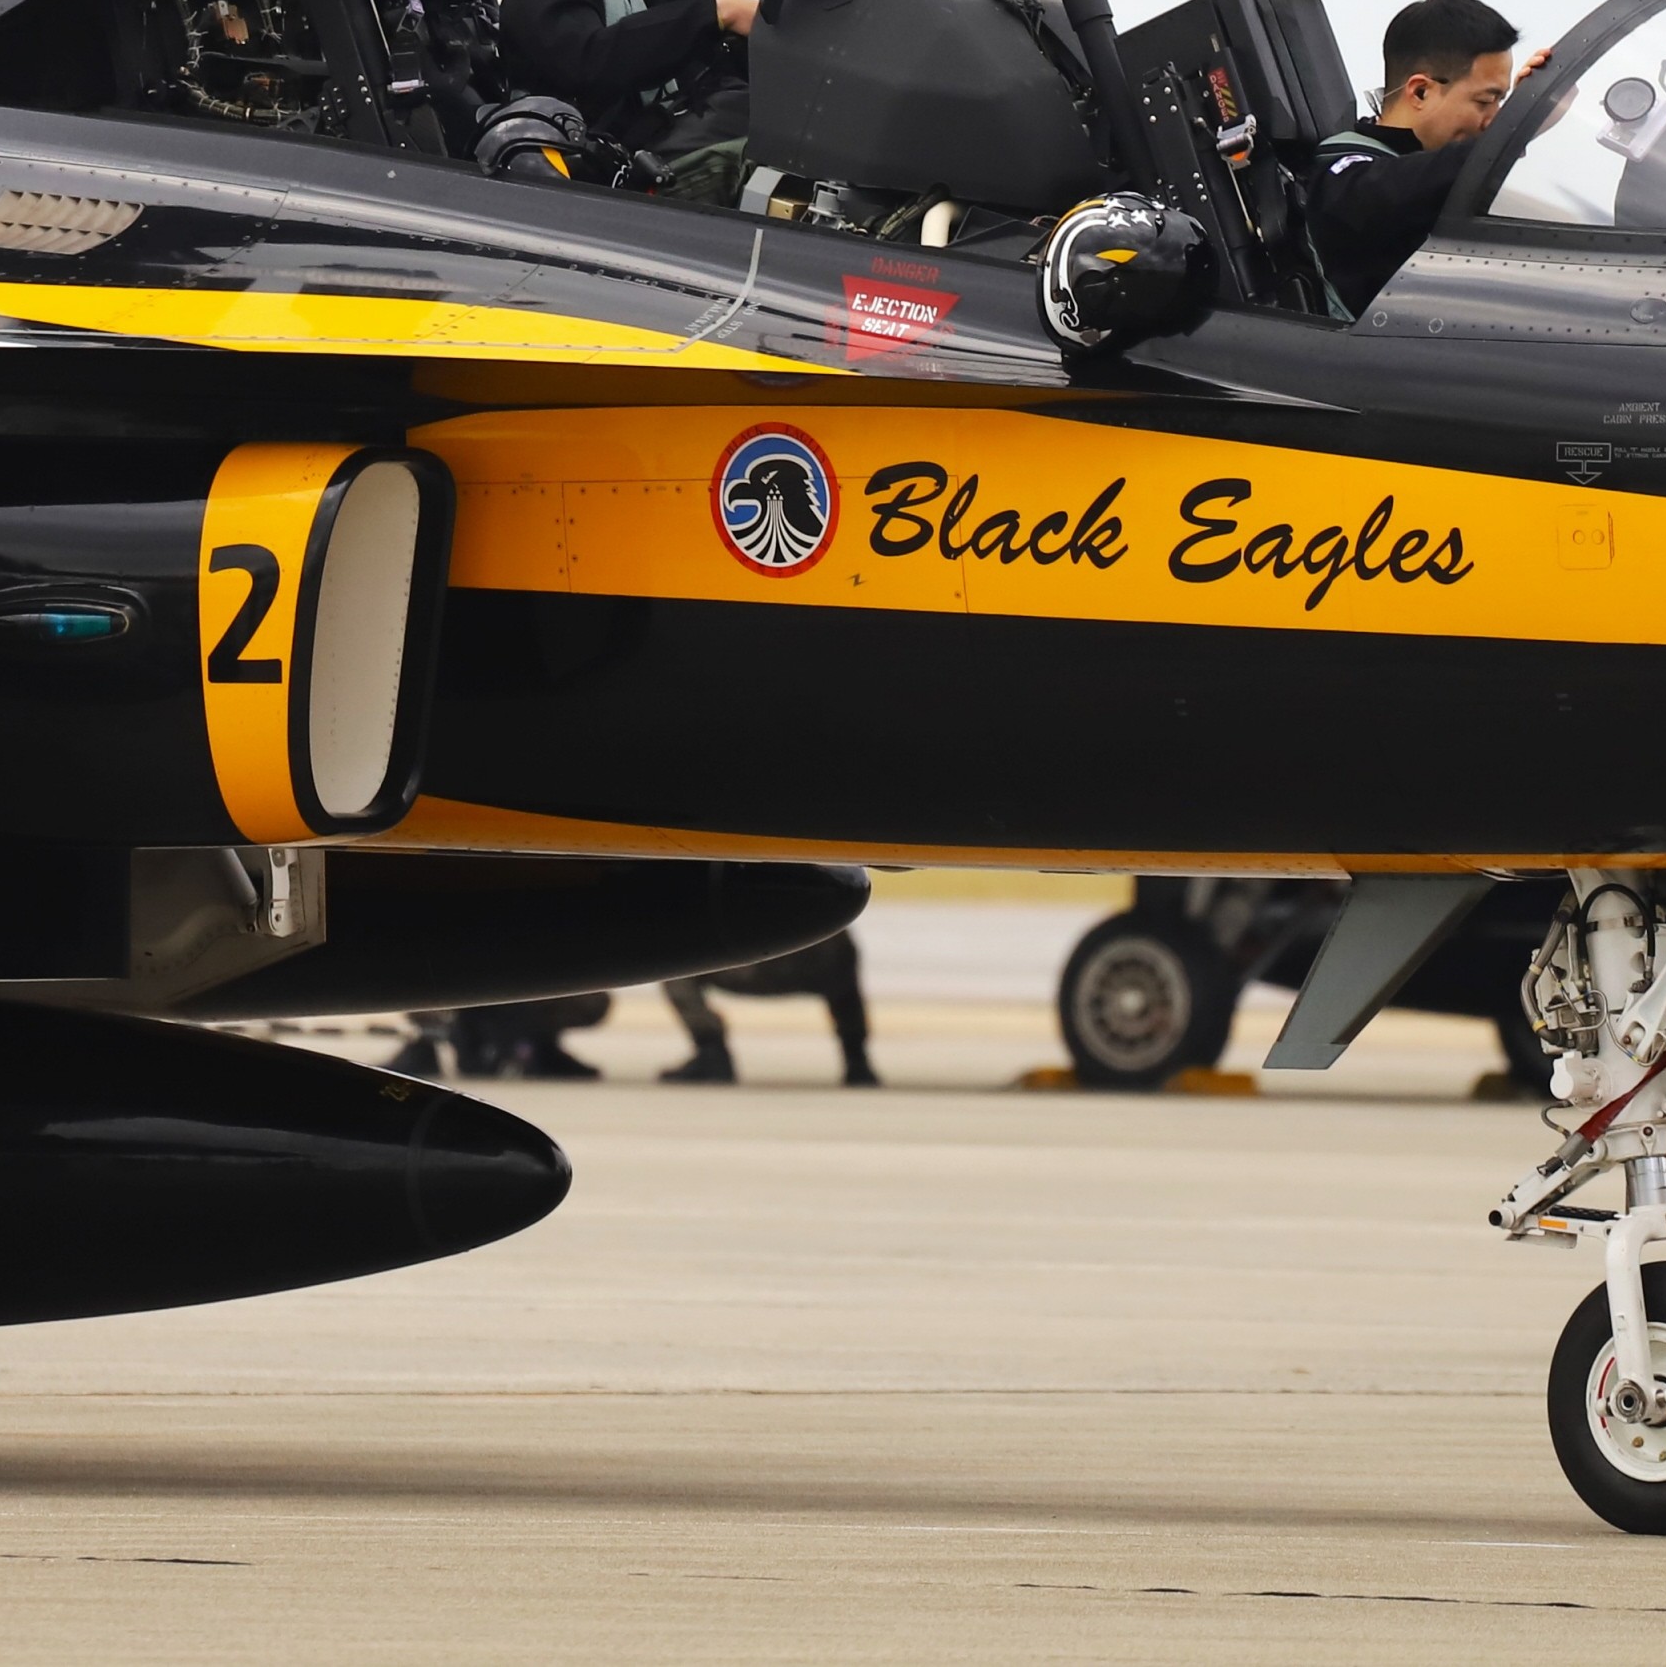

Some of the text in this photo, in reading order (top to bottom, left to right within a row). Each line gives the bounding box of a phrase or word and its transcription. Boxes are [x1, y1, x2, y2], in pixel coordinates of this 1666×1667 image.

[1210, 75, 1229, 122] DANGER
[871, 256, 940, 284] DANGER
[852, 293, 938, 324] EJECTION
[861, 317, 910, 338] SEAT
[1603, 414, 1632, 424] CABIN
[1618, 402, 1661, 412] AMBIENT
[1564, 446, 1603, 457] RESCUE
[863, 459, 1475, 612] Black Eagles
[207, 543, 284, 685] 2
